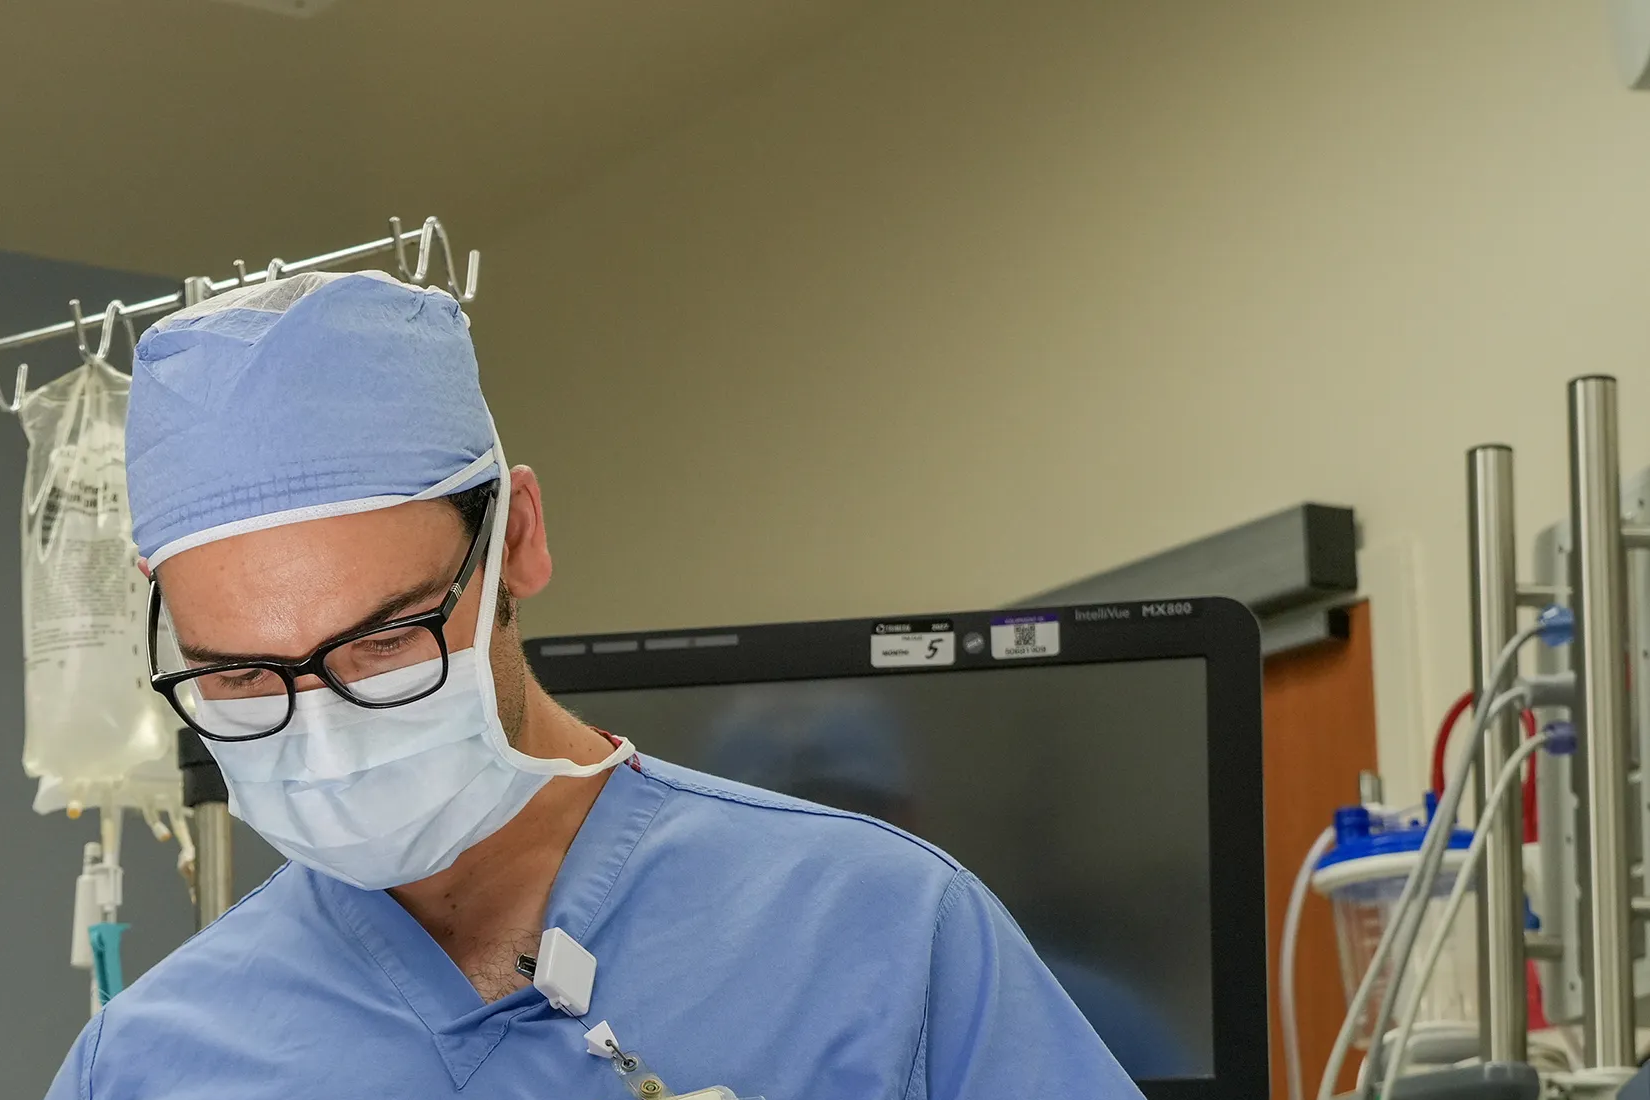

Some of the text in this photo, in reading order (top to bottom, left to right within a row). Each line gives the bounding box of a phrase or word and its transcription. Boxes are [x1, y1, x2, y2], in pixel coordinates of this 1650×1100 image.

[1074, 602, 1193, 621] IntelliVue MX800
[924, 637, 944, 660] 5
